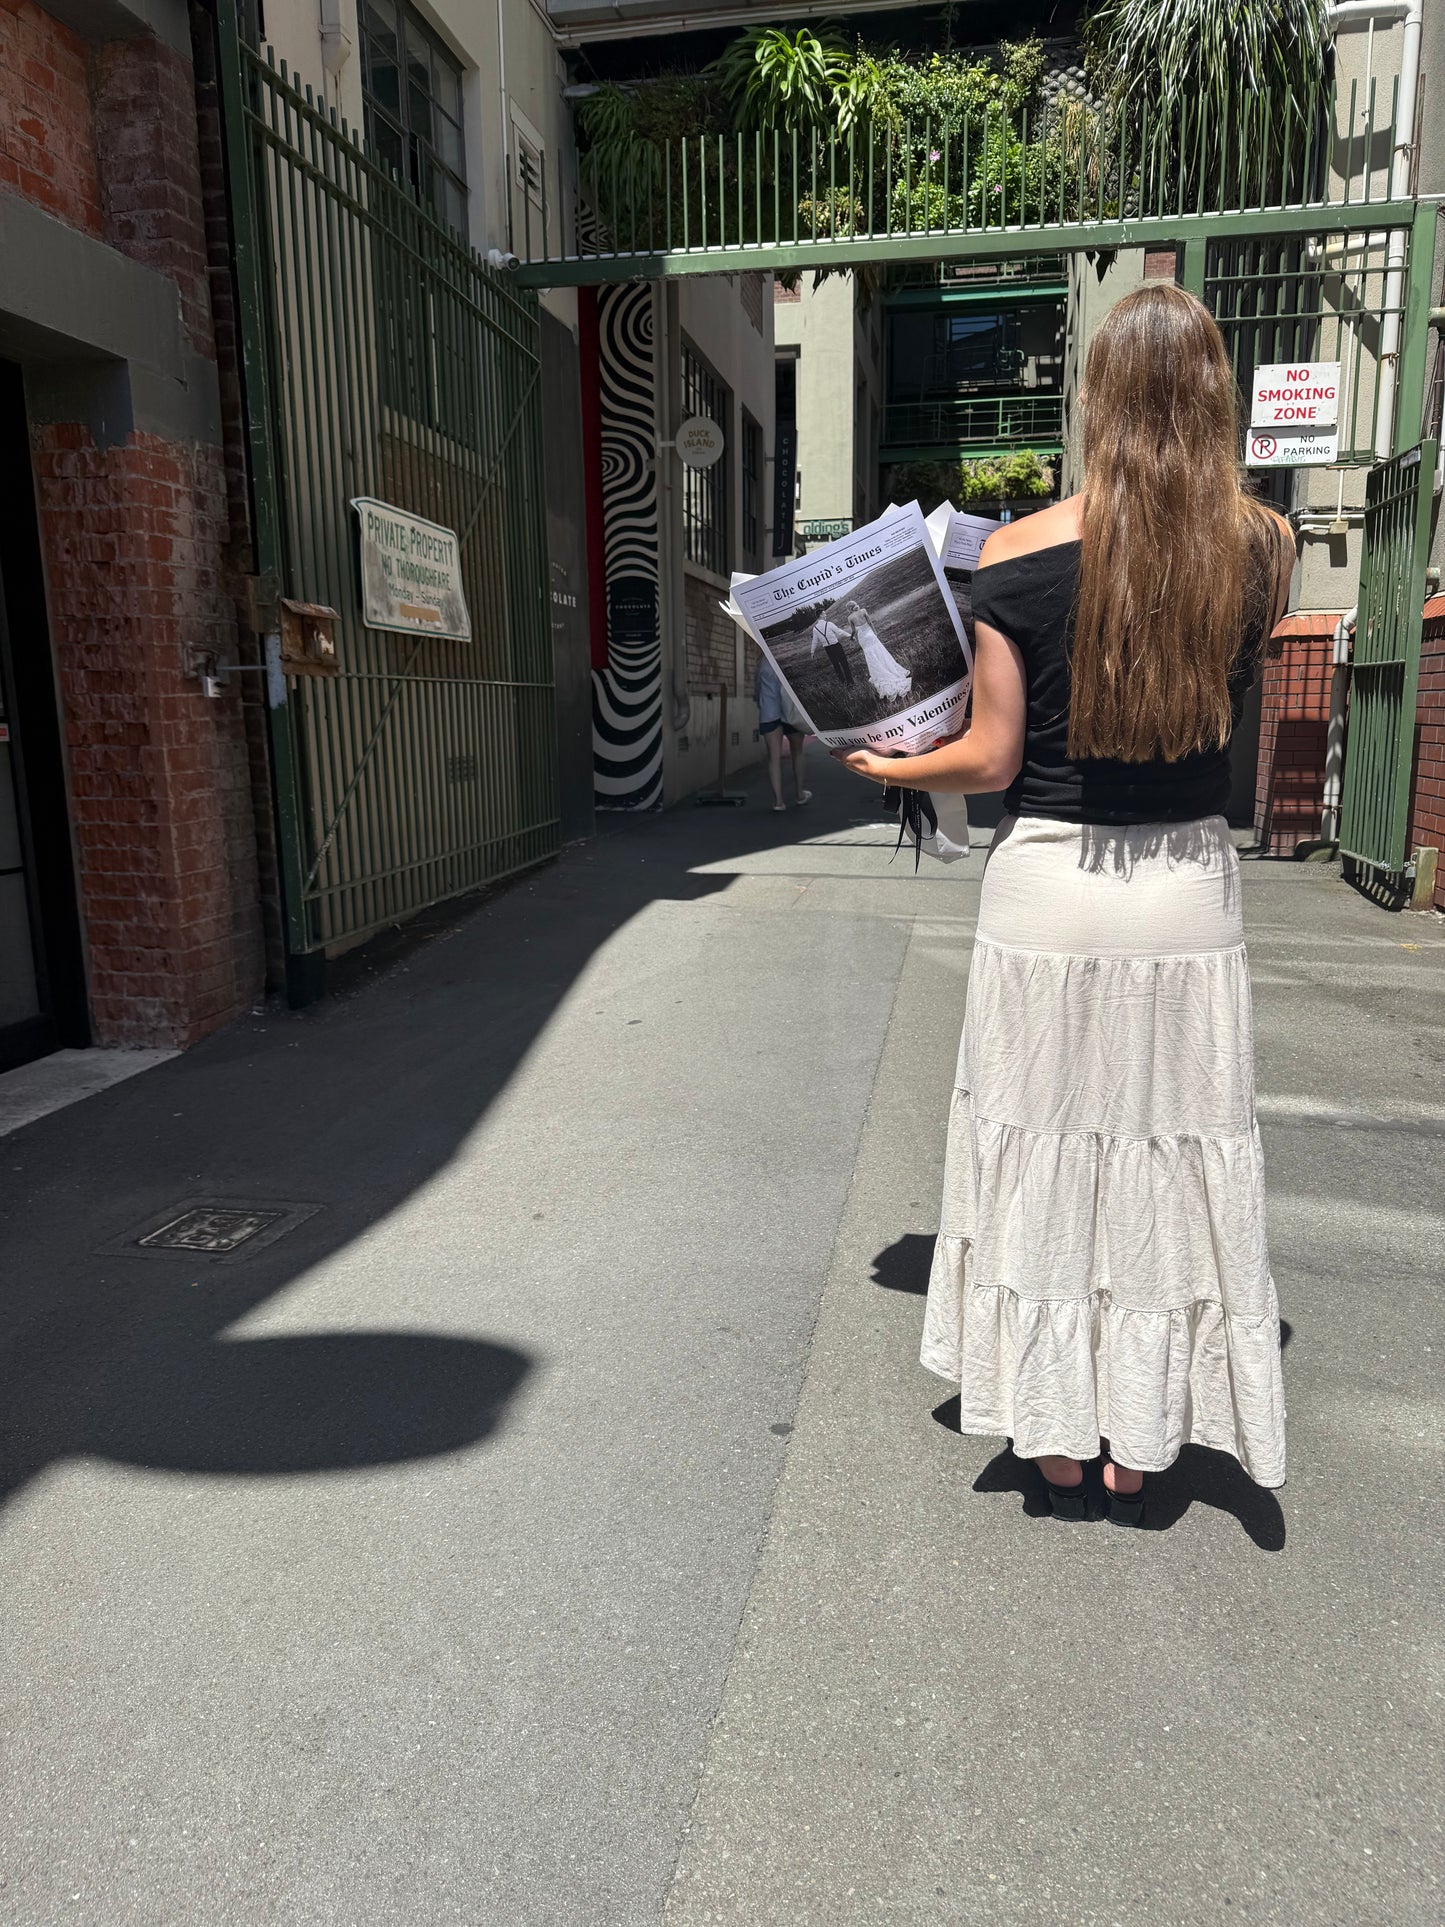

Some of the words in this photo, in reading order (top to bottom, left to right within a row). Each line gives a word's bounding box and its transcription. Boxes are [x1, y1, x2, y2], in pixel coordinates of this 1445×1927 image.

[1286, 369, 1310, 382] NO
[1257, 387, 1336, 402] SMOKING
[1273, 406, 1317, 420] ZONE
[688, 429, 709, 438] DUCK
[1300, 435, 1315, 444] NO
[683, 438, 715, 448] ISLAND
[1283, 446, 1331, 456] PARKING
[367, 511, 406, 552] PRIVATE
[410, 526, 454, 567] PROPERTY
[381, 552, 392, 576] NO
[773, 586, 795, 601] The
[797, 565, 843, 591] Cupid's
[845, 545, 882, 568] Times
[396, 558, 451, 591] THOROUGHFARE
[388, 583, 414, 604] Monday
[825, 736, 848, 746] Will
[848, 736, 868, 746] you
[868, 733, 883, 743] be
[884, 724, 904, 740] my
